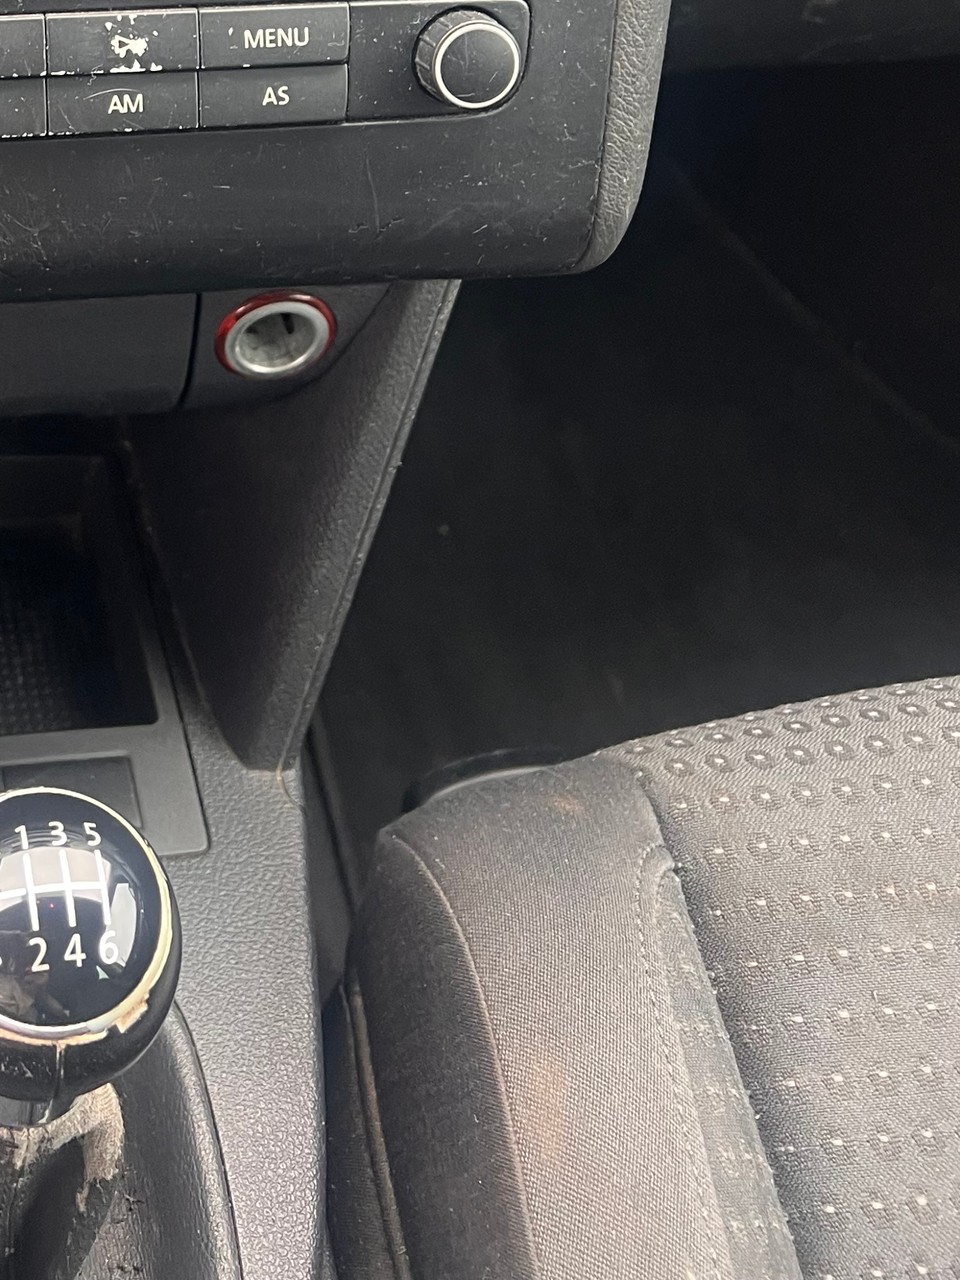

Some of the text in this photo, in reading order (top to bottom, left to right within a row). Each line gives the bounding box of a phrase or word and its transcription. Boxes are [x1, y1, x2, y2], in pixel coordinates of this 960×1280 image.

[243, 27, 310, 49] MENU
[106, 94, 144, 115] AM
[262, 85, 290, 107] AS
[14, 825, 29, 850] 1
[48, 820, 68, 846] 3
[82, 821, 102, 847] 5
[29, 930, 119, 973] 2 4 6
